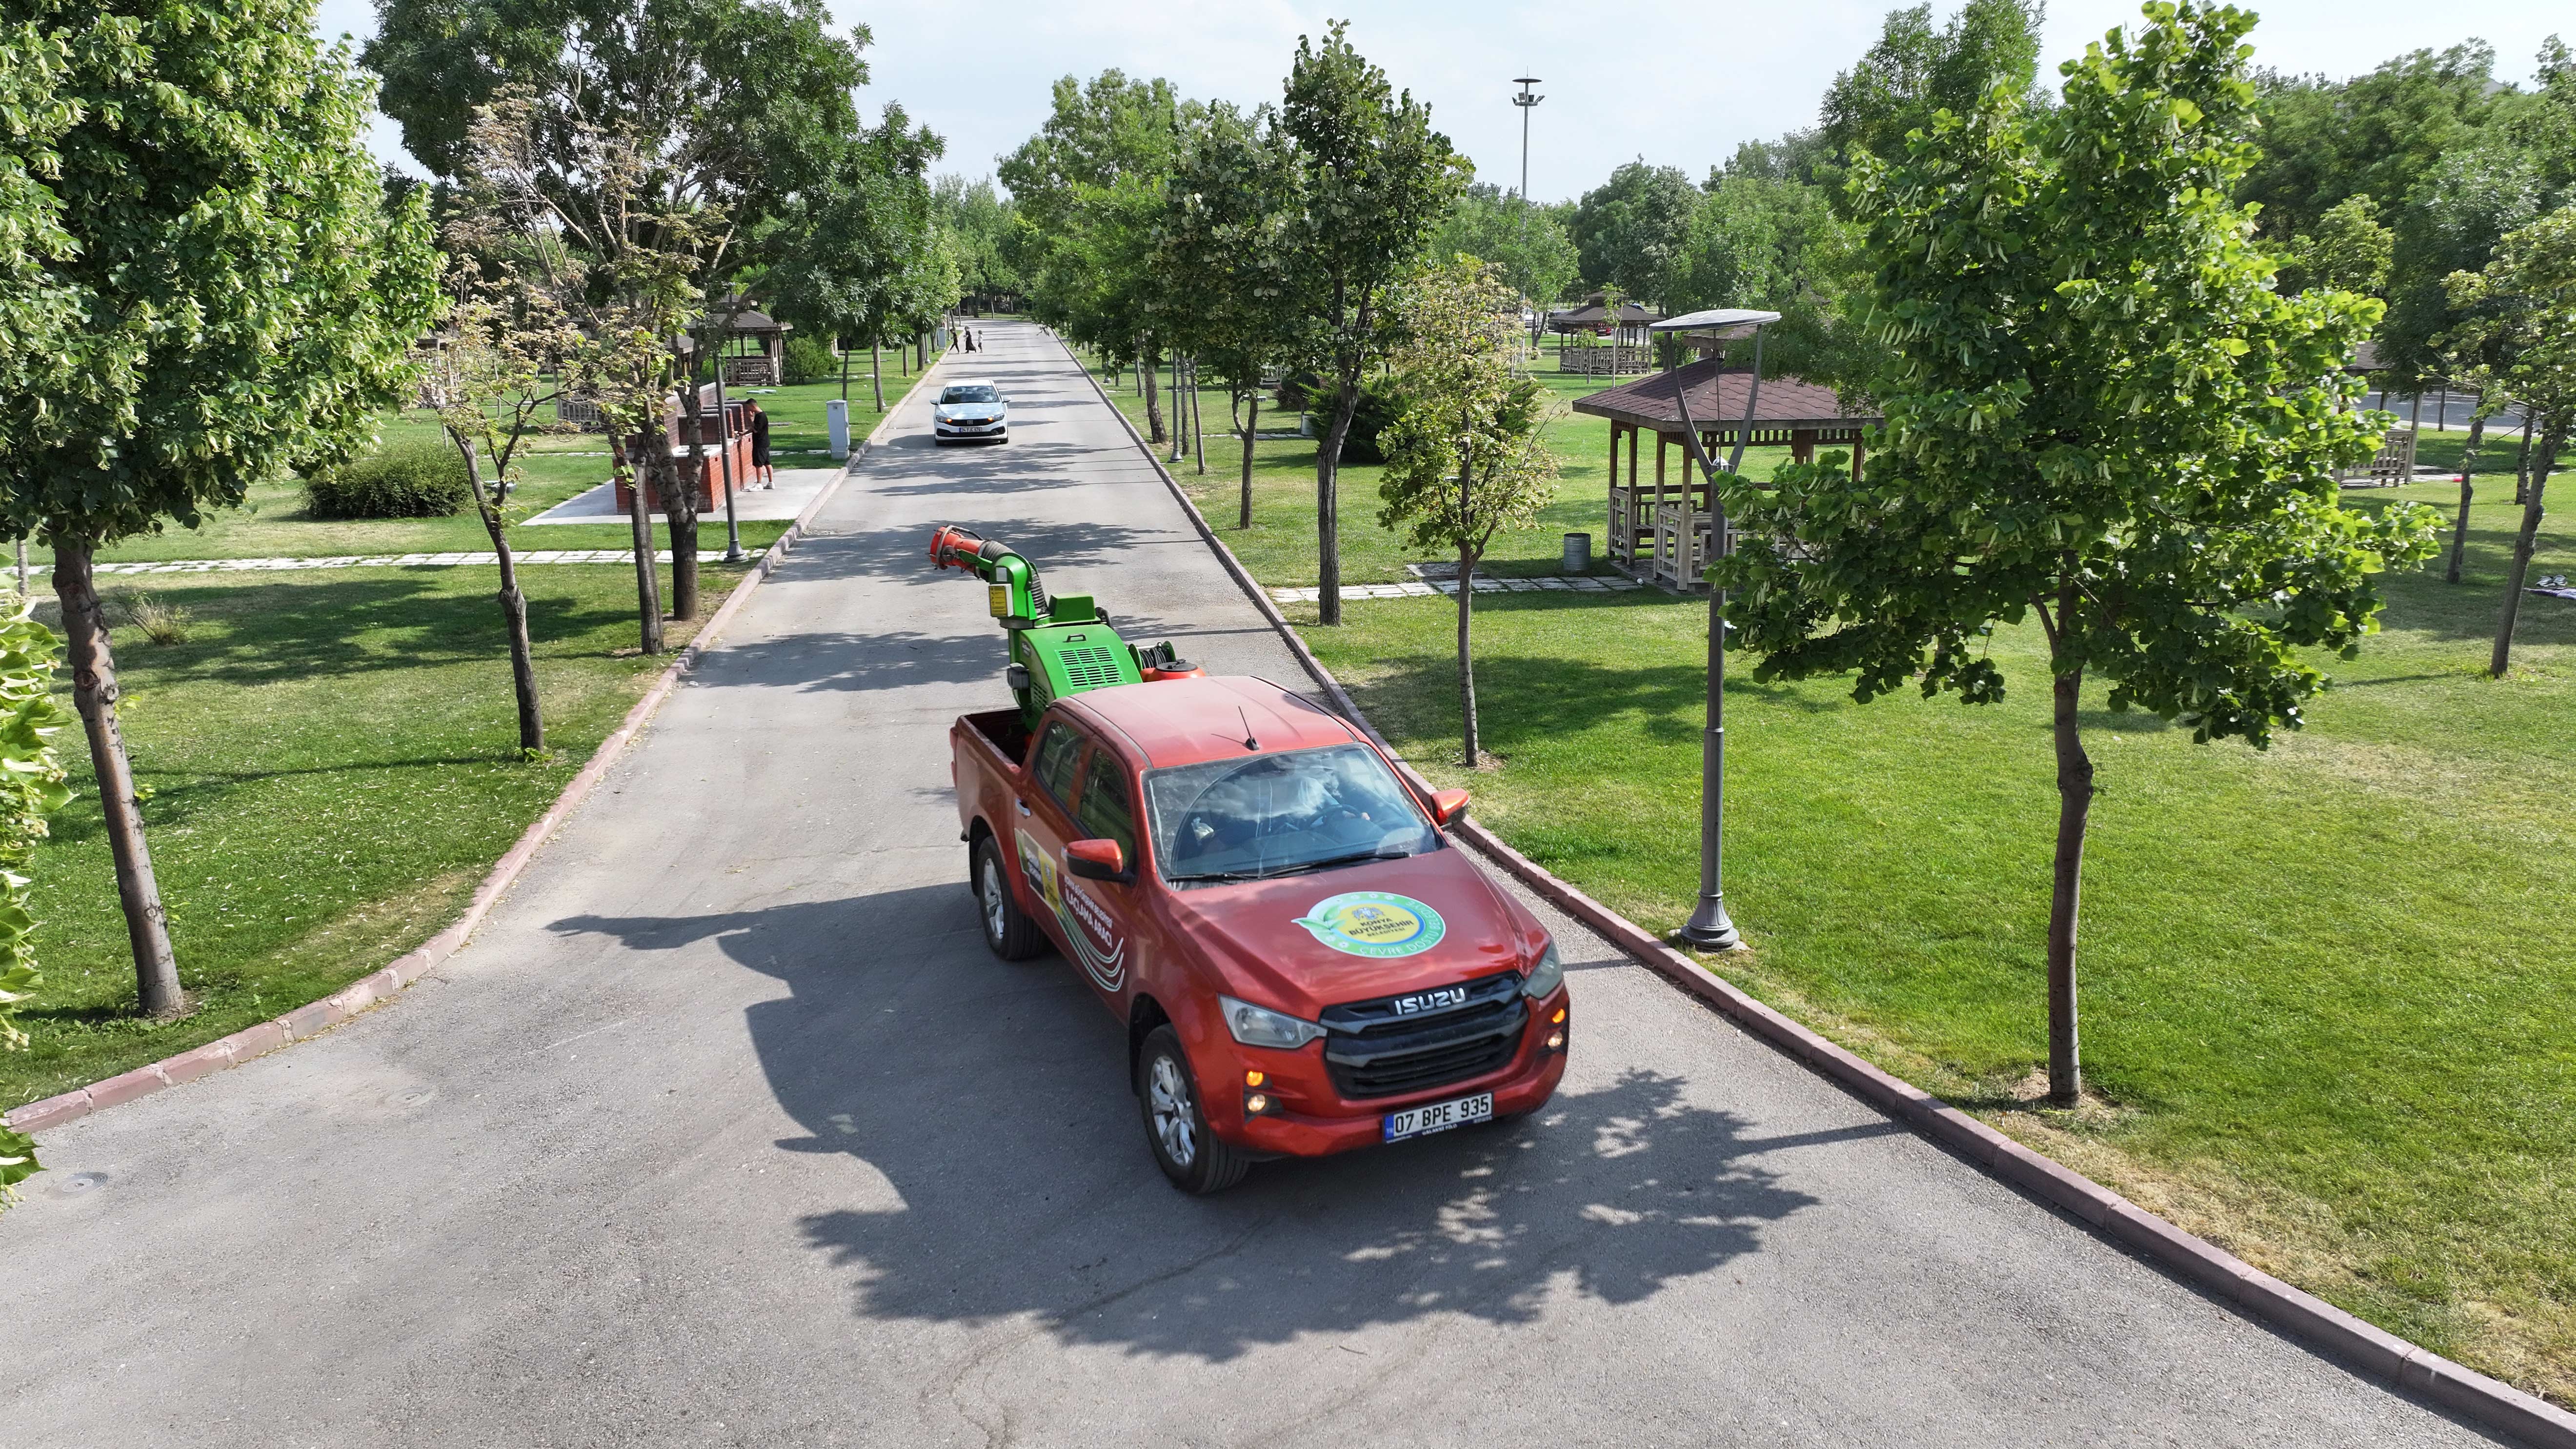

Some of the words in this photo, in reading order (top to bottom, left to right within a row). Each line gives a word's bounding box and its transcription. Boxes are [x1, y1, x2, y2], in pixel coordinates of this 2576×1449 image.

[1360, 918, 1391, 926] KONYA
[1407, 929, 1439, 952] DOSTU
[1395, 987, 1466, 1015] ISUZU
[1395, 1113, 1414, 1133] 07
[1422, 1105, 1452, 1127] BPE
[1461, 1095, 1489, 1118] 935
